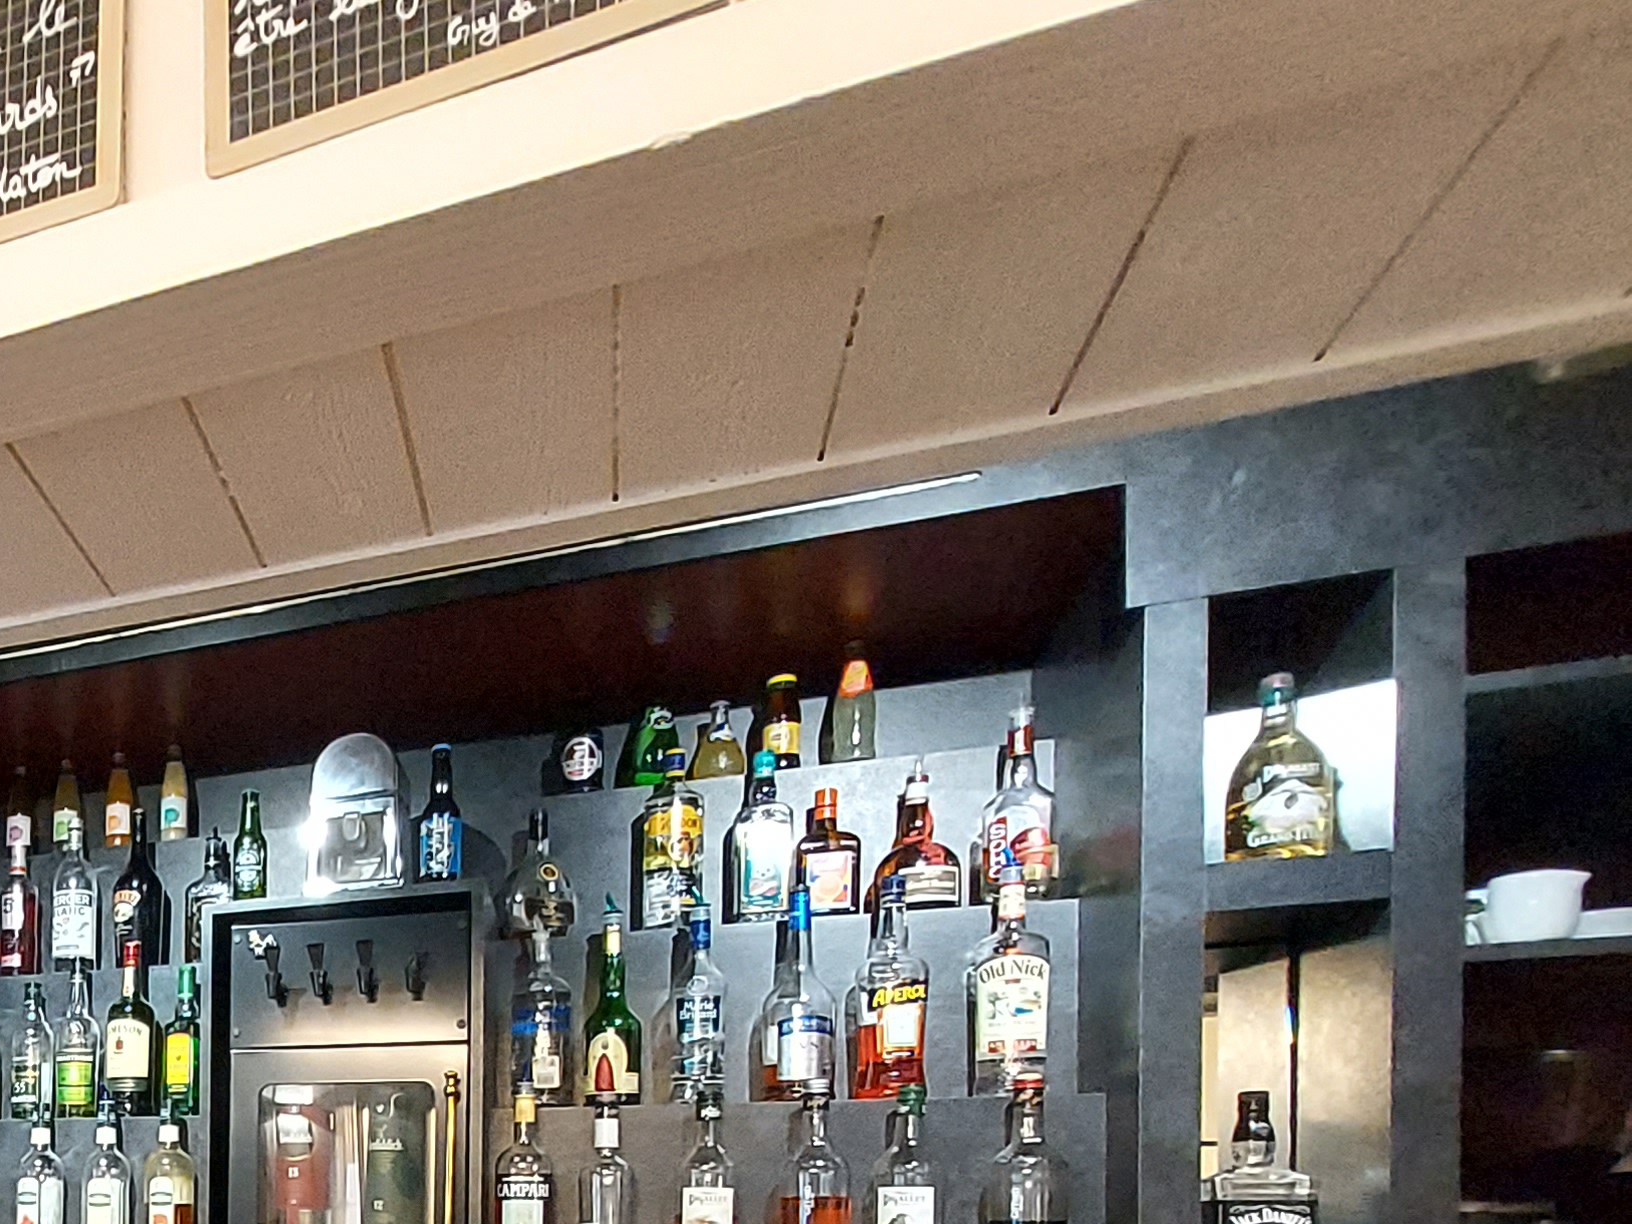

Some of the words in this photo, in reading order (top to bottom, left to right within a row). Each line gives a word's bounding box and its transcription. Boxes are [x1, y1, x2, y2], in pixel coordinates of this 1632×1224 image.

[22, 0, 79, 44] le
[978, 960, 1007, 985] Old
[1013, 956, 1047, 981] Nick
[871, 984, 927, 1009] APEROL
[497, 1182, 550, 1199] CAMPARI
